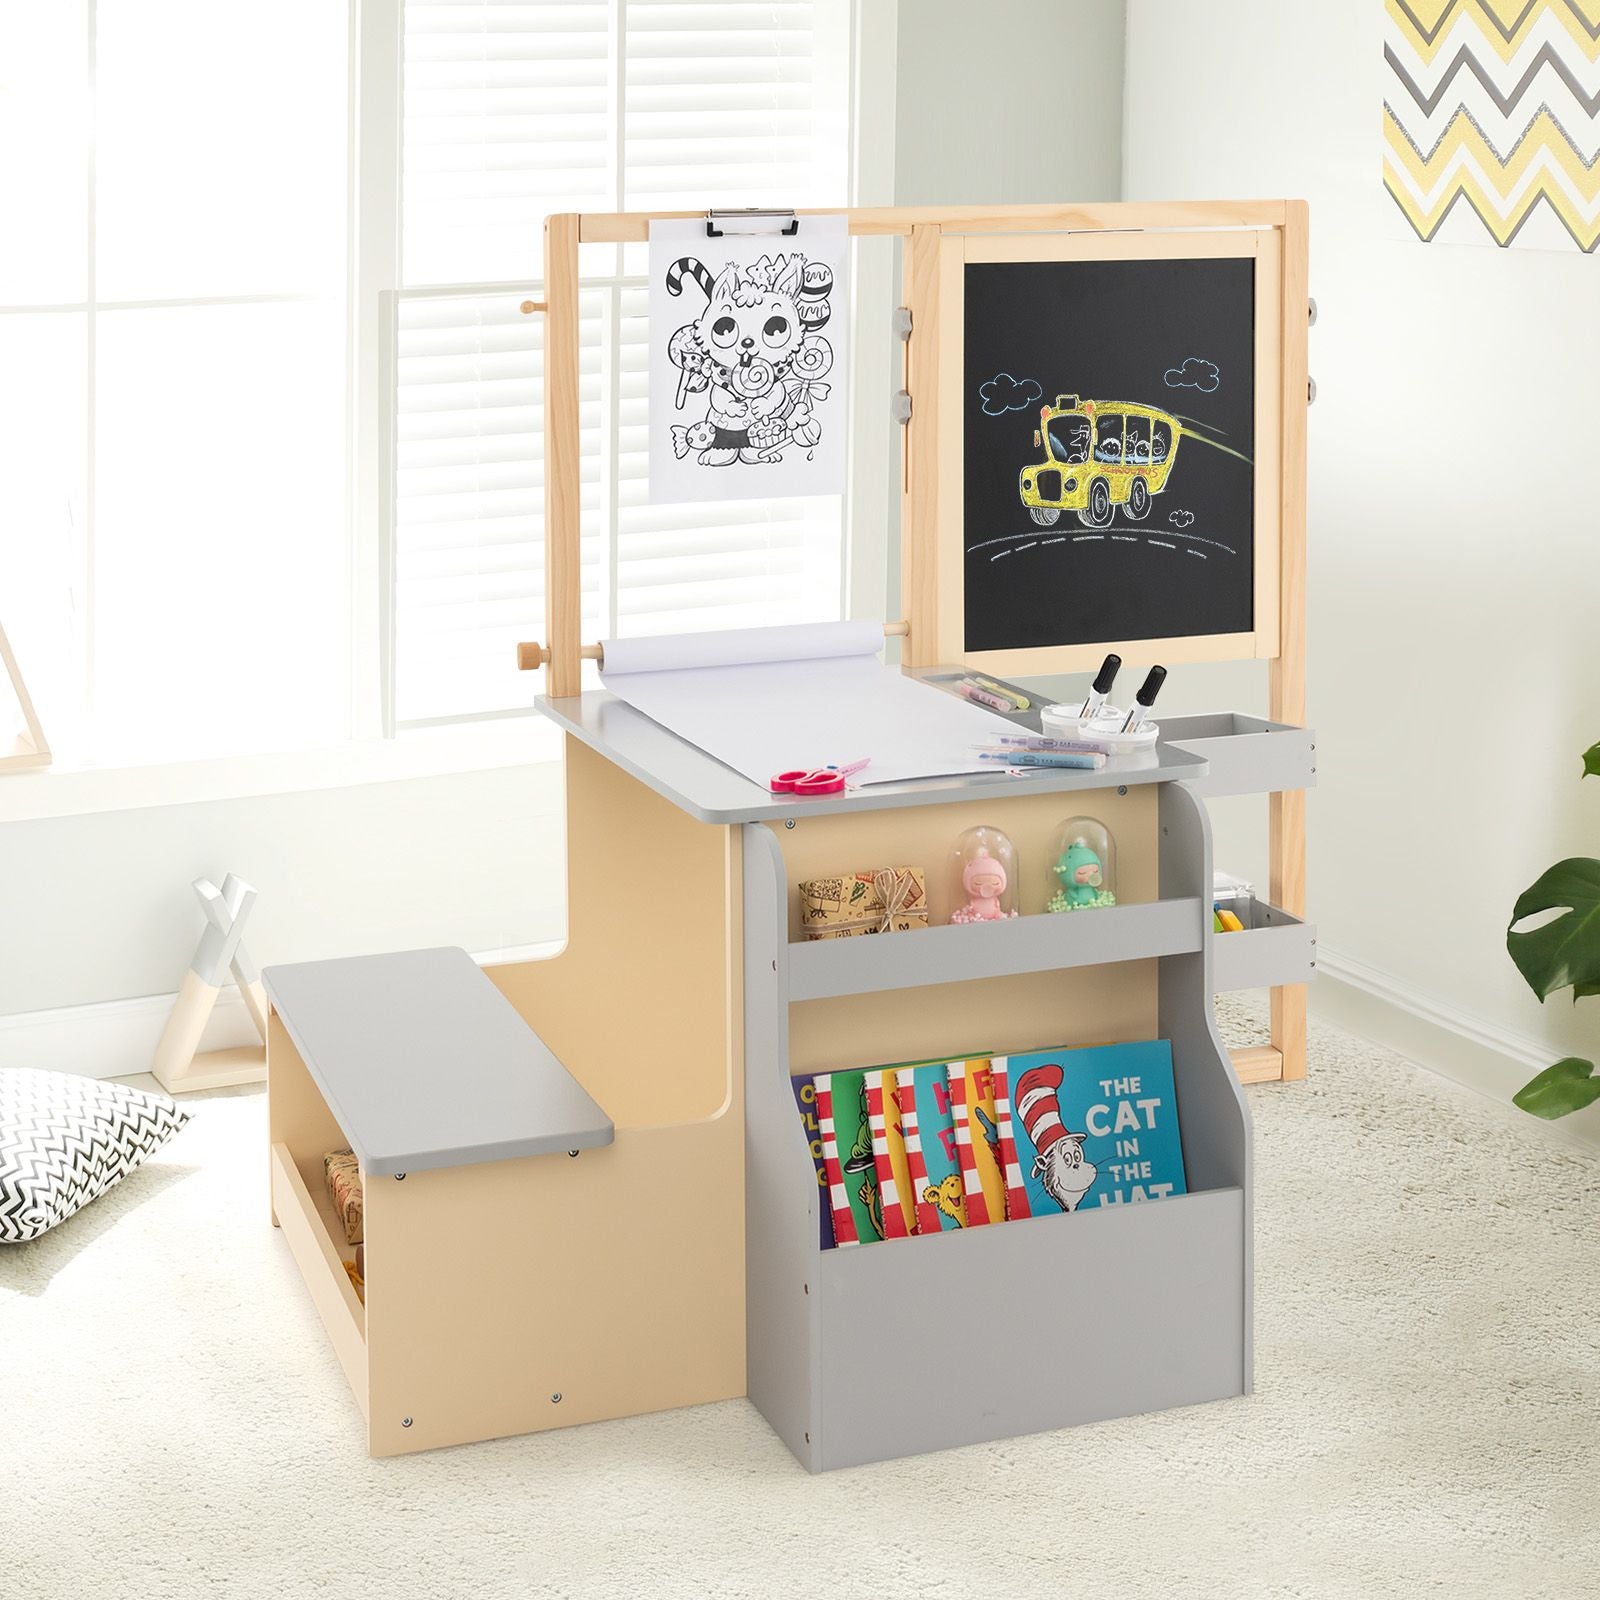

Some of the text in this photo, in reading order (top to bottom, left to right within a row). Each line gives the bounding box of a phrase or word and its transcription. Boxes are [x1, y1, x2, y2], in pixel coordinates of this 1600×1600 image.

[1099, 1076, 1141, 1097] THE
[1085, 1097, 1161, 1137] CAT
[1115, 1138, 1140, 1158] IN
[1108, 1161, 1152, 1183] THE
